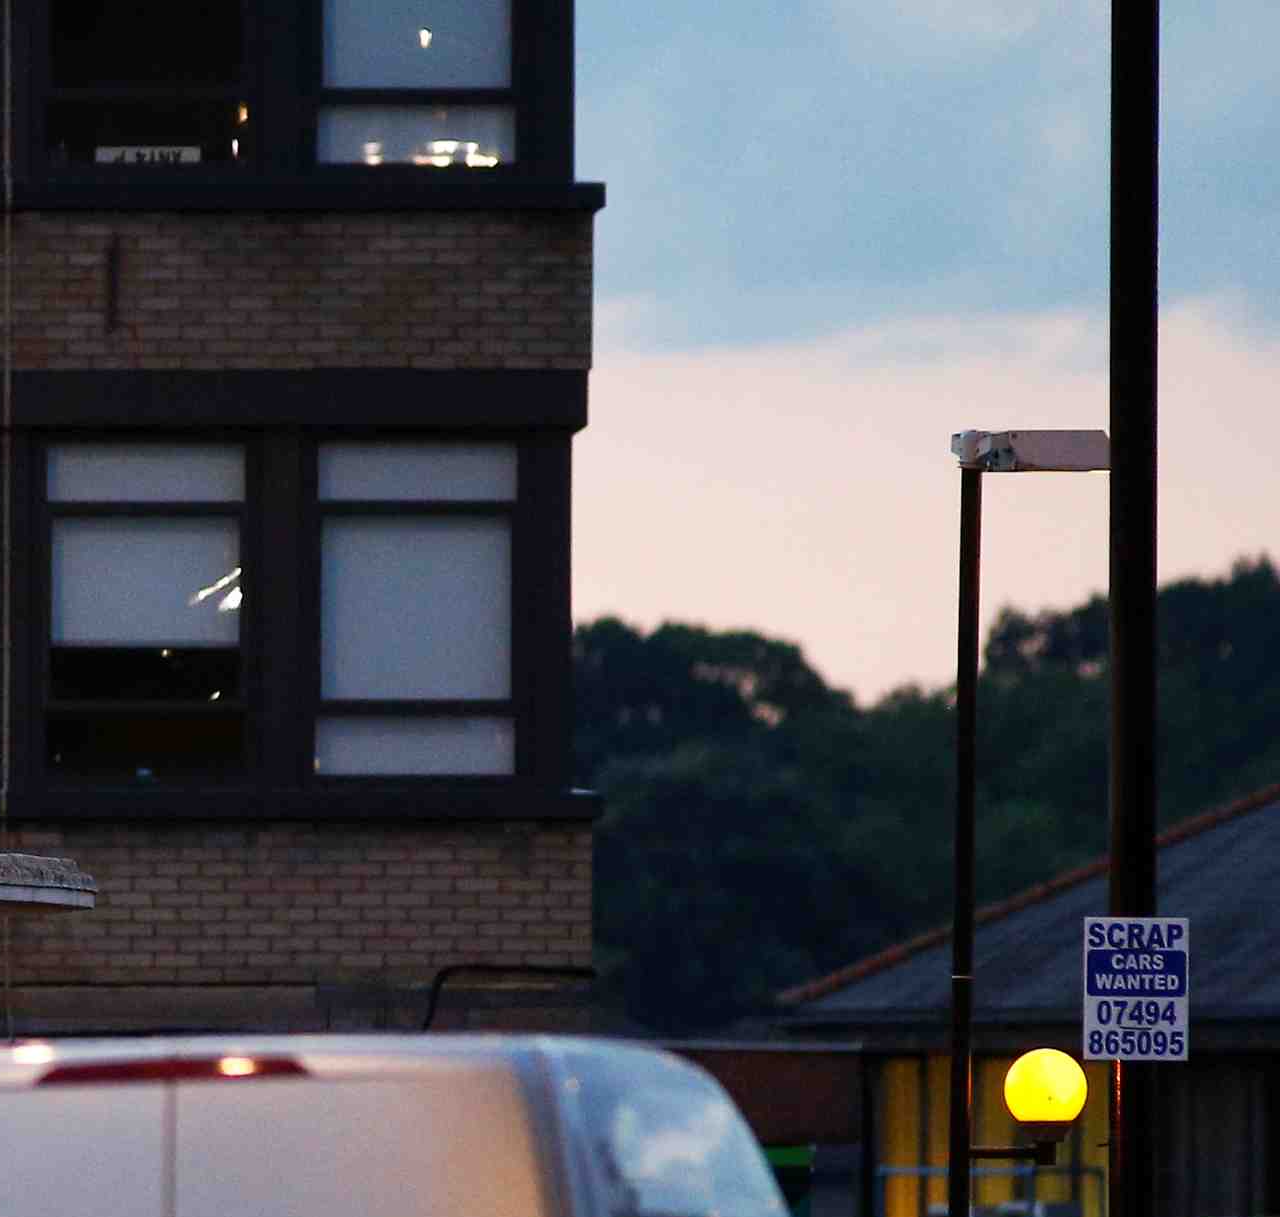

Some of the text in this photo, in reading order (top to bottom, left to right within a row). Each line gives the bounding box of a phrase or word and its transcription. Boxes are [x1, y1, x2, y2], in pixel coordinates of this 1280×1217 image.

[1088, 923, 1183, 949] SCRAP
[1111, 954, 1165, 970] CARS
[1095, 974, 1179, 990] WANTED
[1097, 1001, 1176, 1025] 07494
[1089, 1030, 1184, 1055] 865095
